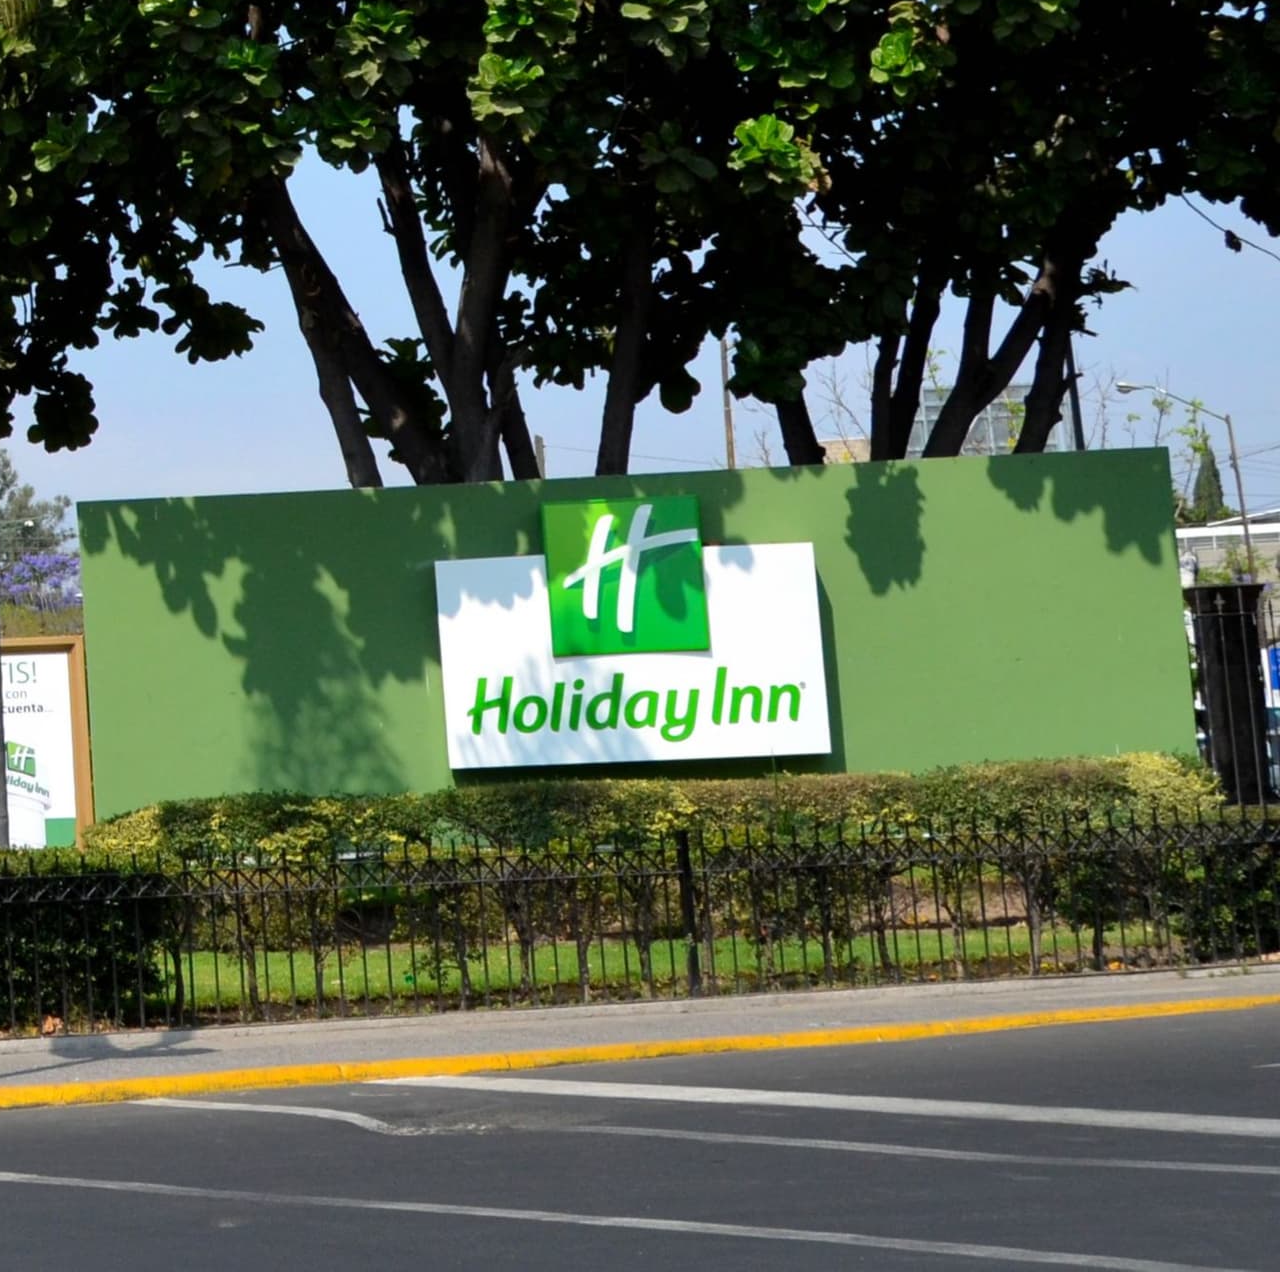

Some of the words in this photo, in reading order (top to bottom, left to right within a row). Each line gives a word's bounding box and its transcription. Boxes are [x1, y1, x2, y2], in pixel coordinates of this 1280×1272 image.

[5, 690, 28, 699] con
[466, 672, 700, 743] Holiday
[712, 666, 801, 726] Inn
